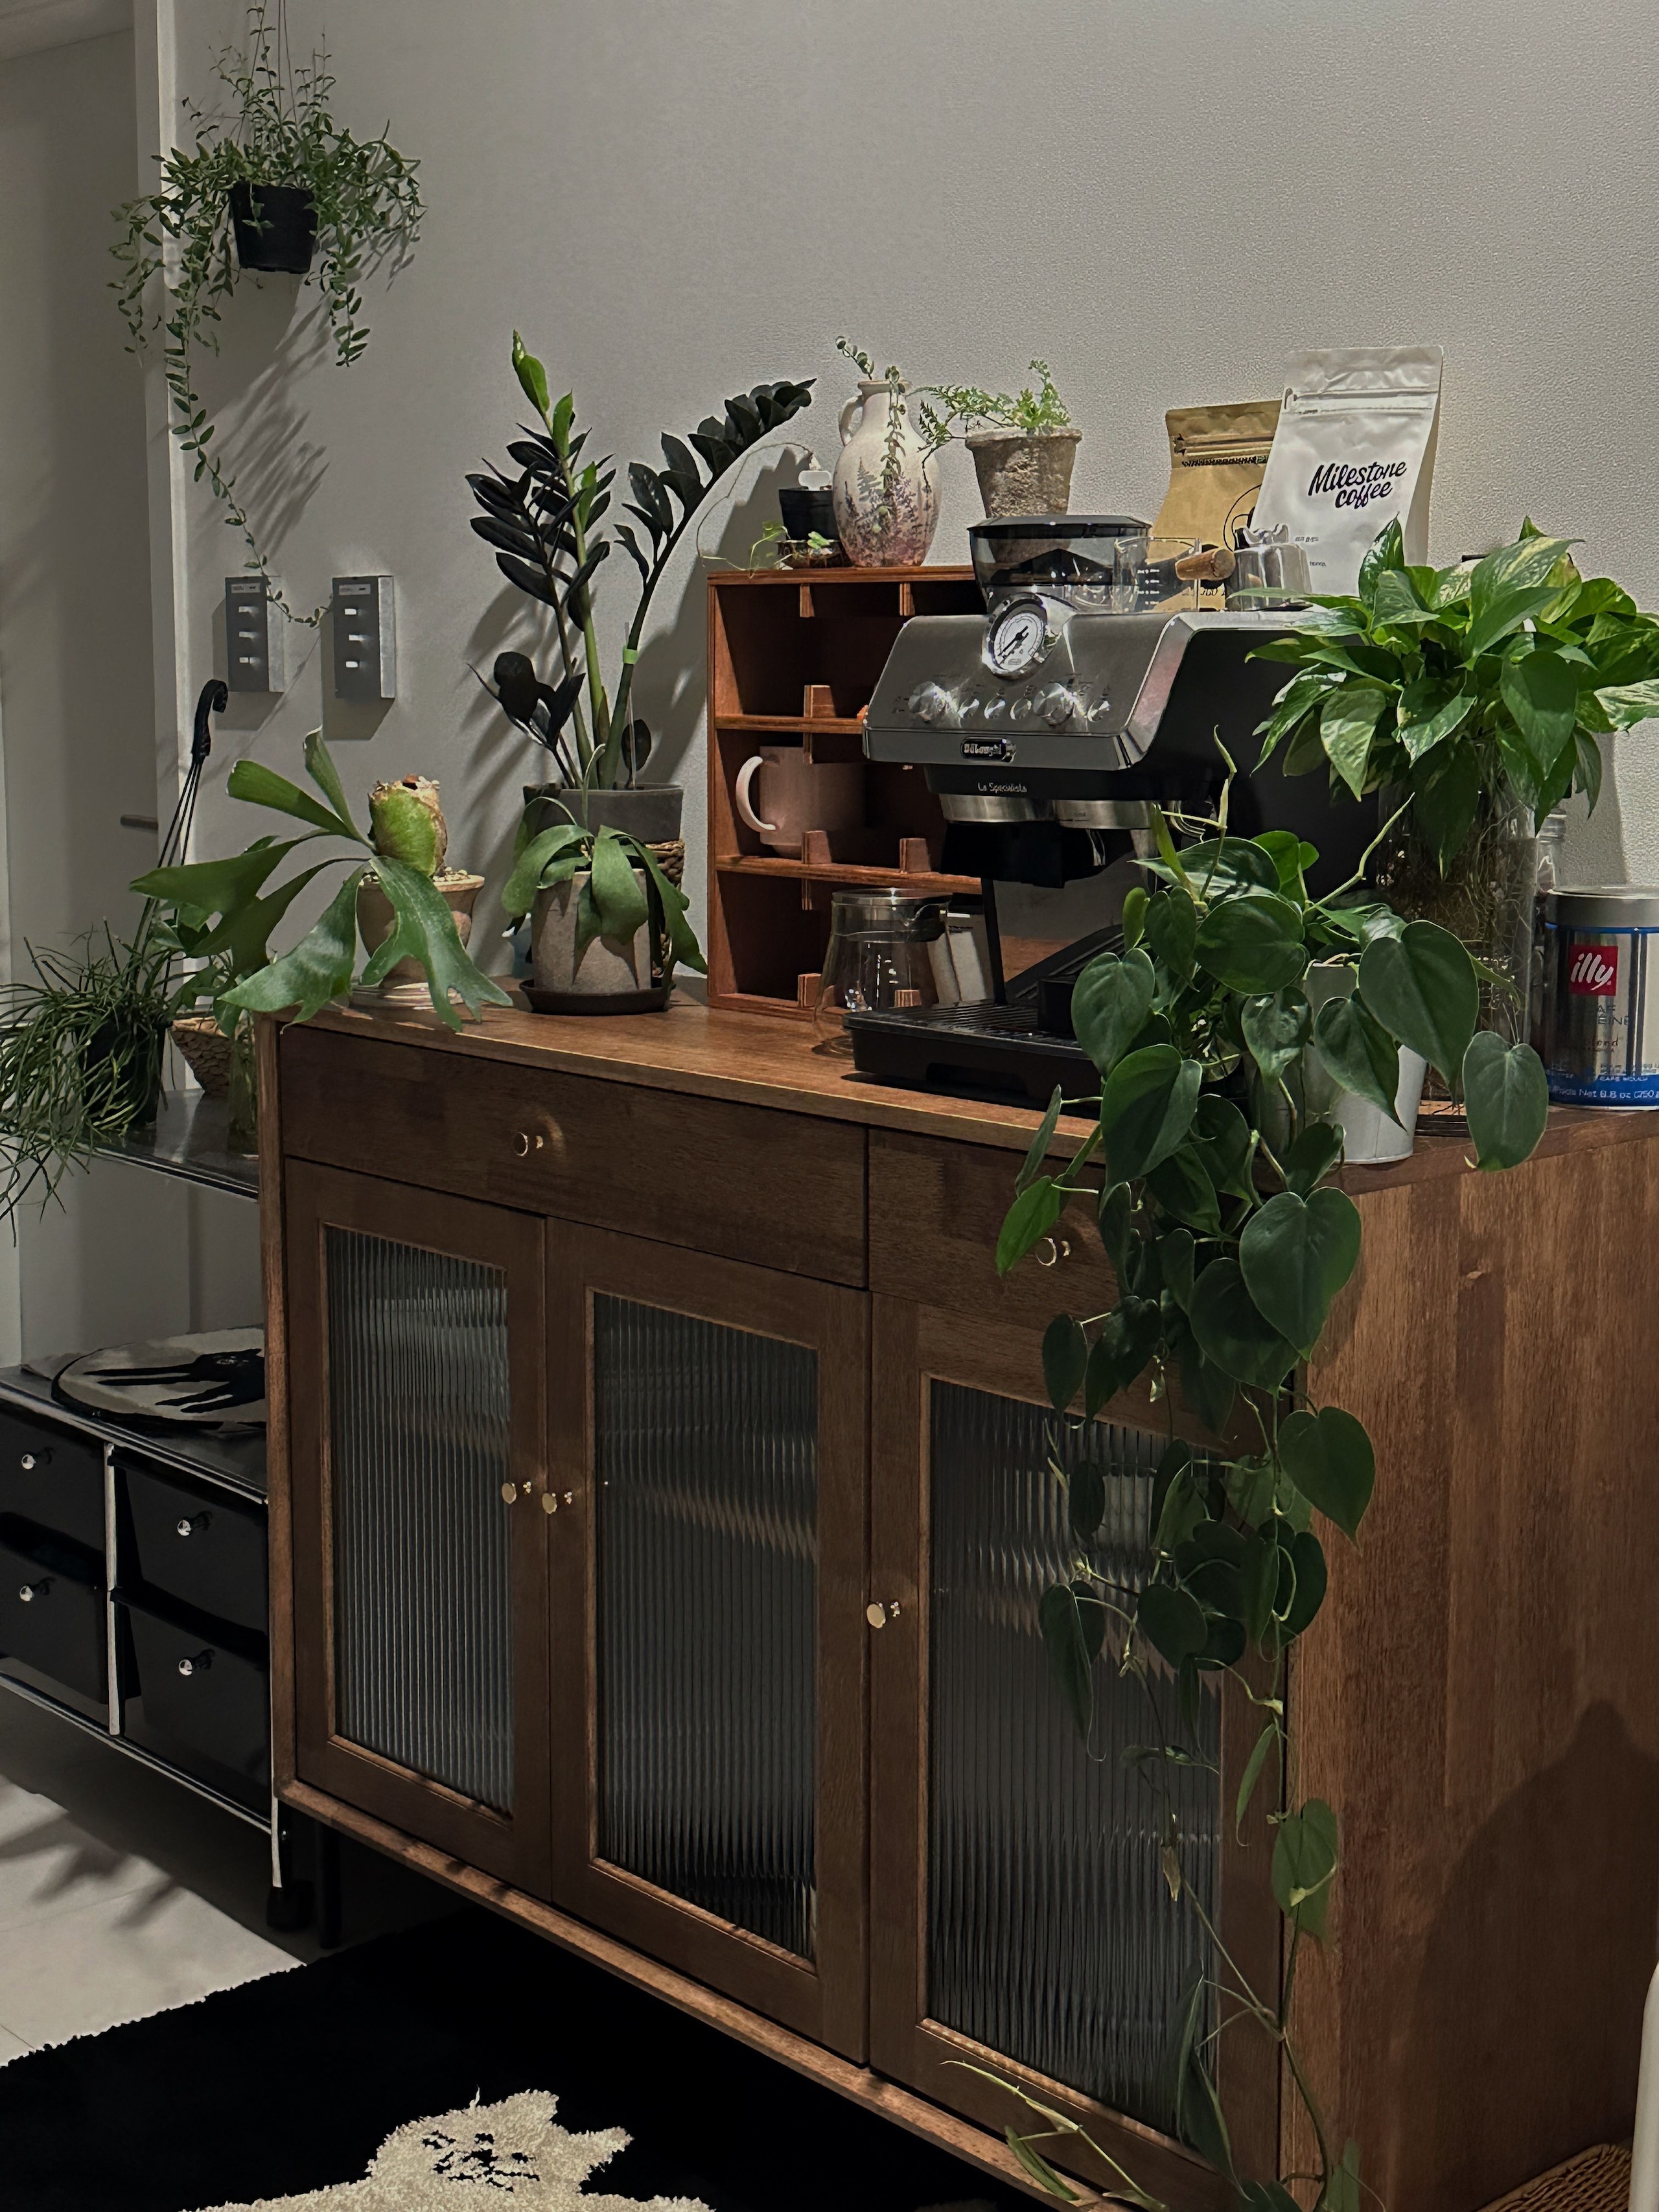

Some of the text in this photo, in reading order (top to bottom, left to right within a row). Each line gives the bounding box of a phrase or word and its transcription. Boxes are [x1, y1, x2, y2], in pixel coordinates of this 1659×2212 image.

[1308, 461, 1407, 496] Milestone
[1335, 482, 1393, 509] coffee
[1570, 952, 1614, 990] illy
